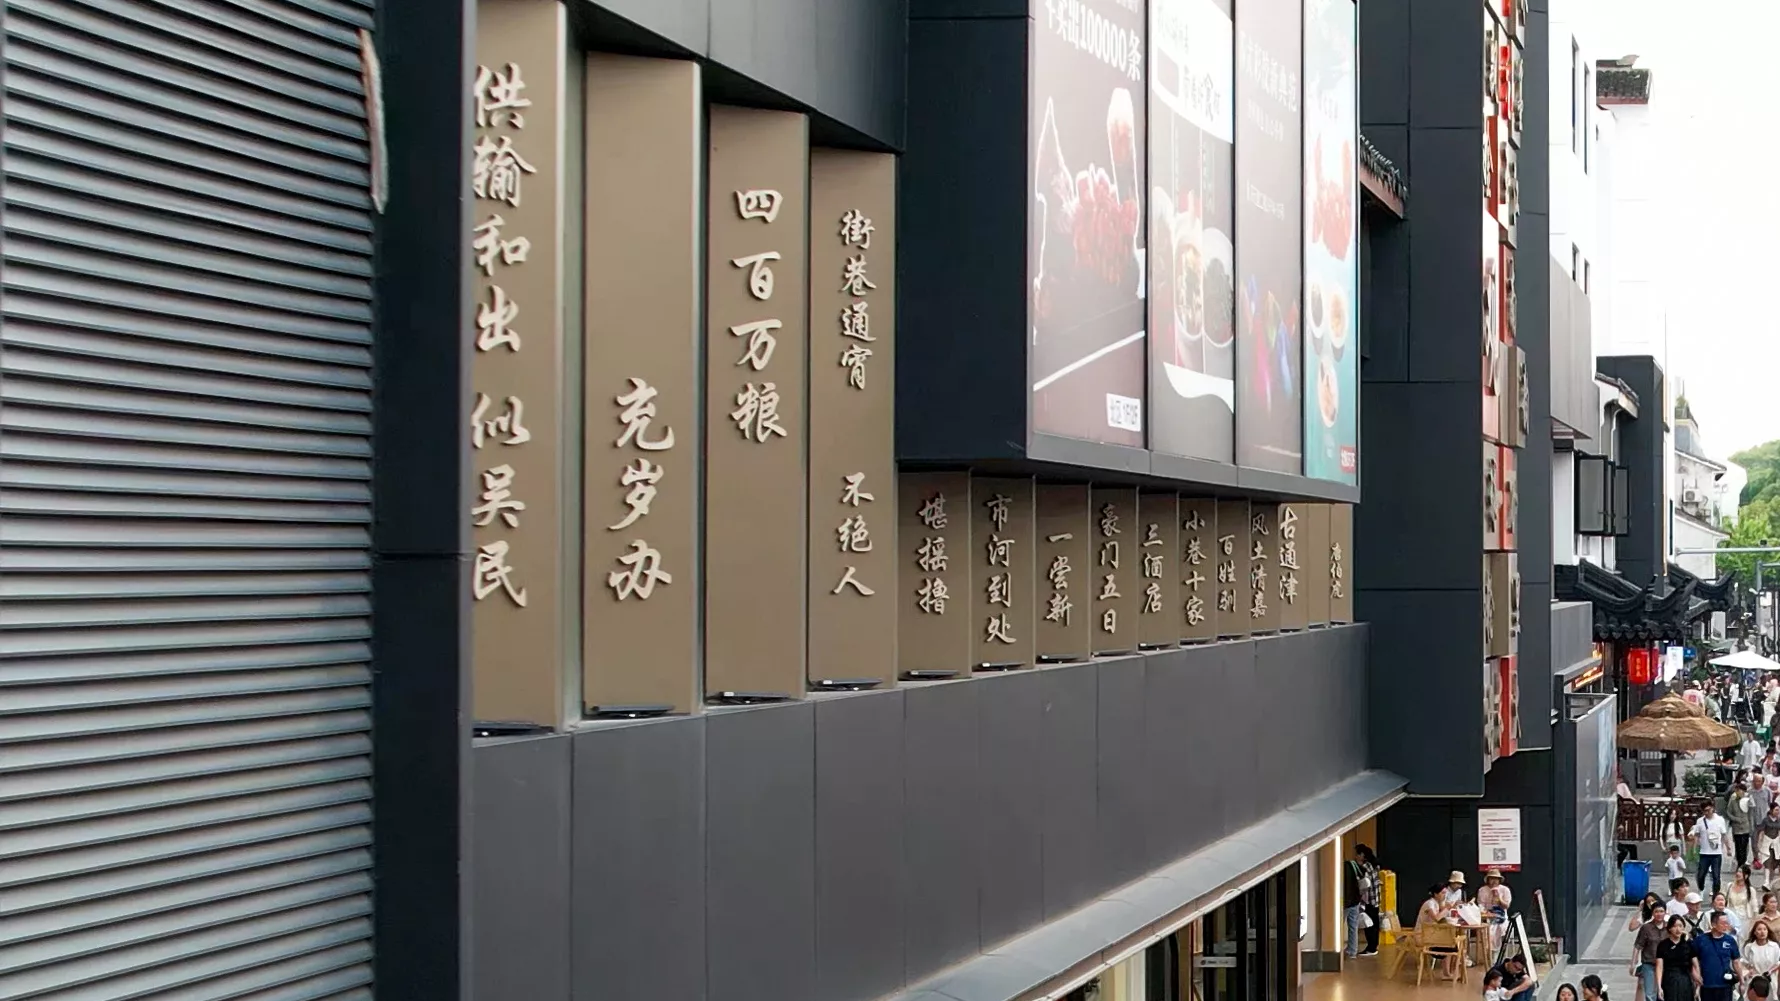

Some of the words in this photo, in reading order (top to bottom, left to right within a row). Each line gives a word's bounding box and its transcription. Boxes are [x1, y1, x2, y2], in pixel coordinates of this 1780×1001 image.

[730, 187, 788, 444] 四百万粮
[606, 376, 674, 602] 充岁办
[832, 472, 876, 597] 不绝人
[987, 494, 1017, 644] 市河到处
[1099, 503, 1122, 634] 豪门五日
[1143, 524, 1164, 615] 三酒店
[1185, 510, 1207, 626] 小巷十家
[1279, 507, 1300, 605] 古通津
